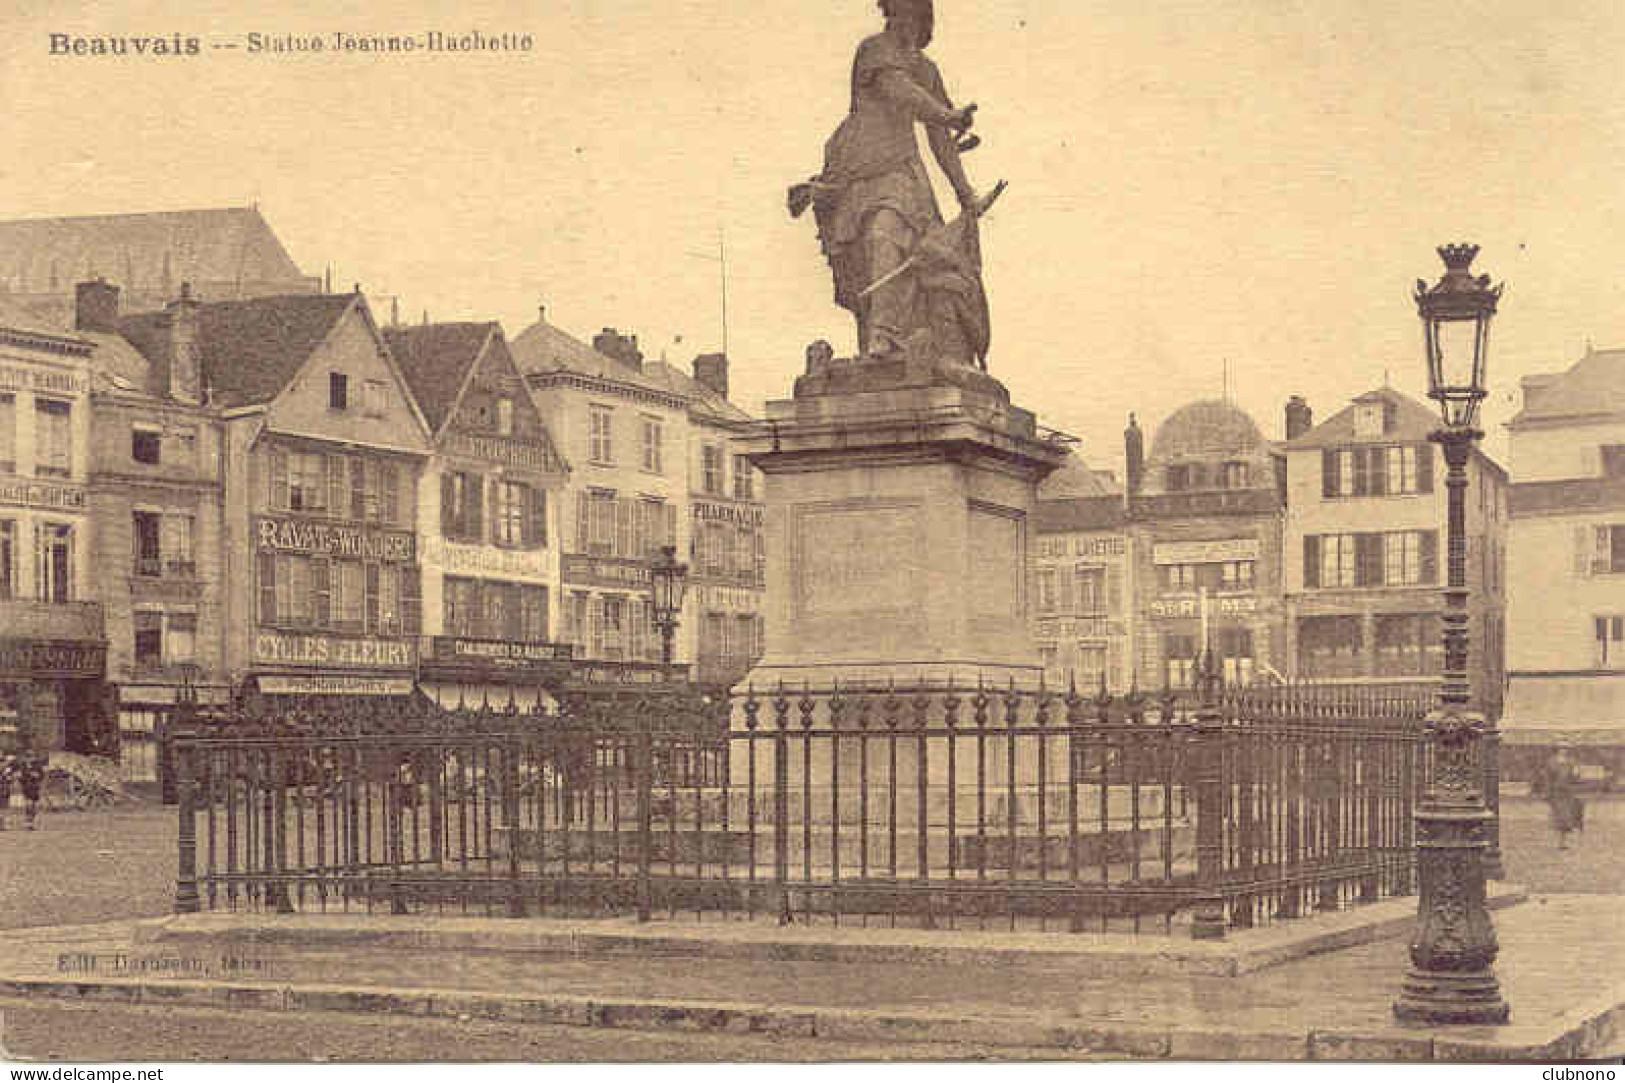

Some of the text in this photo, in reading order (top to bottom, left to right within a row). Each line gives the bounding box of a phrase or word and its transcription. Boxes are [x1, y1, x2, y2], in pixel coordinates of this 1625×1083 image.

[693, 503, 765, 528] PHARMACIE
[257, 634, 410, 665] CYCLES FLEURY
